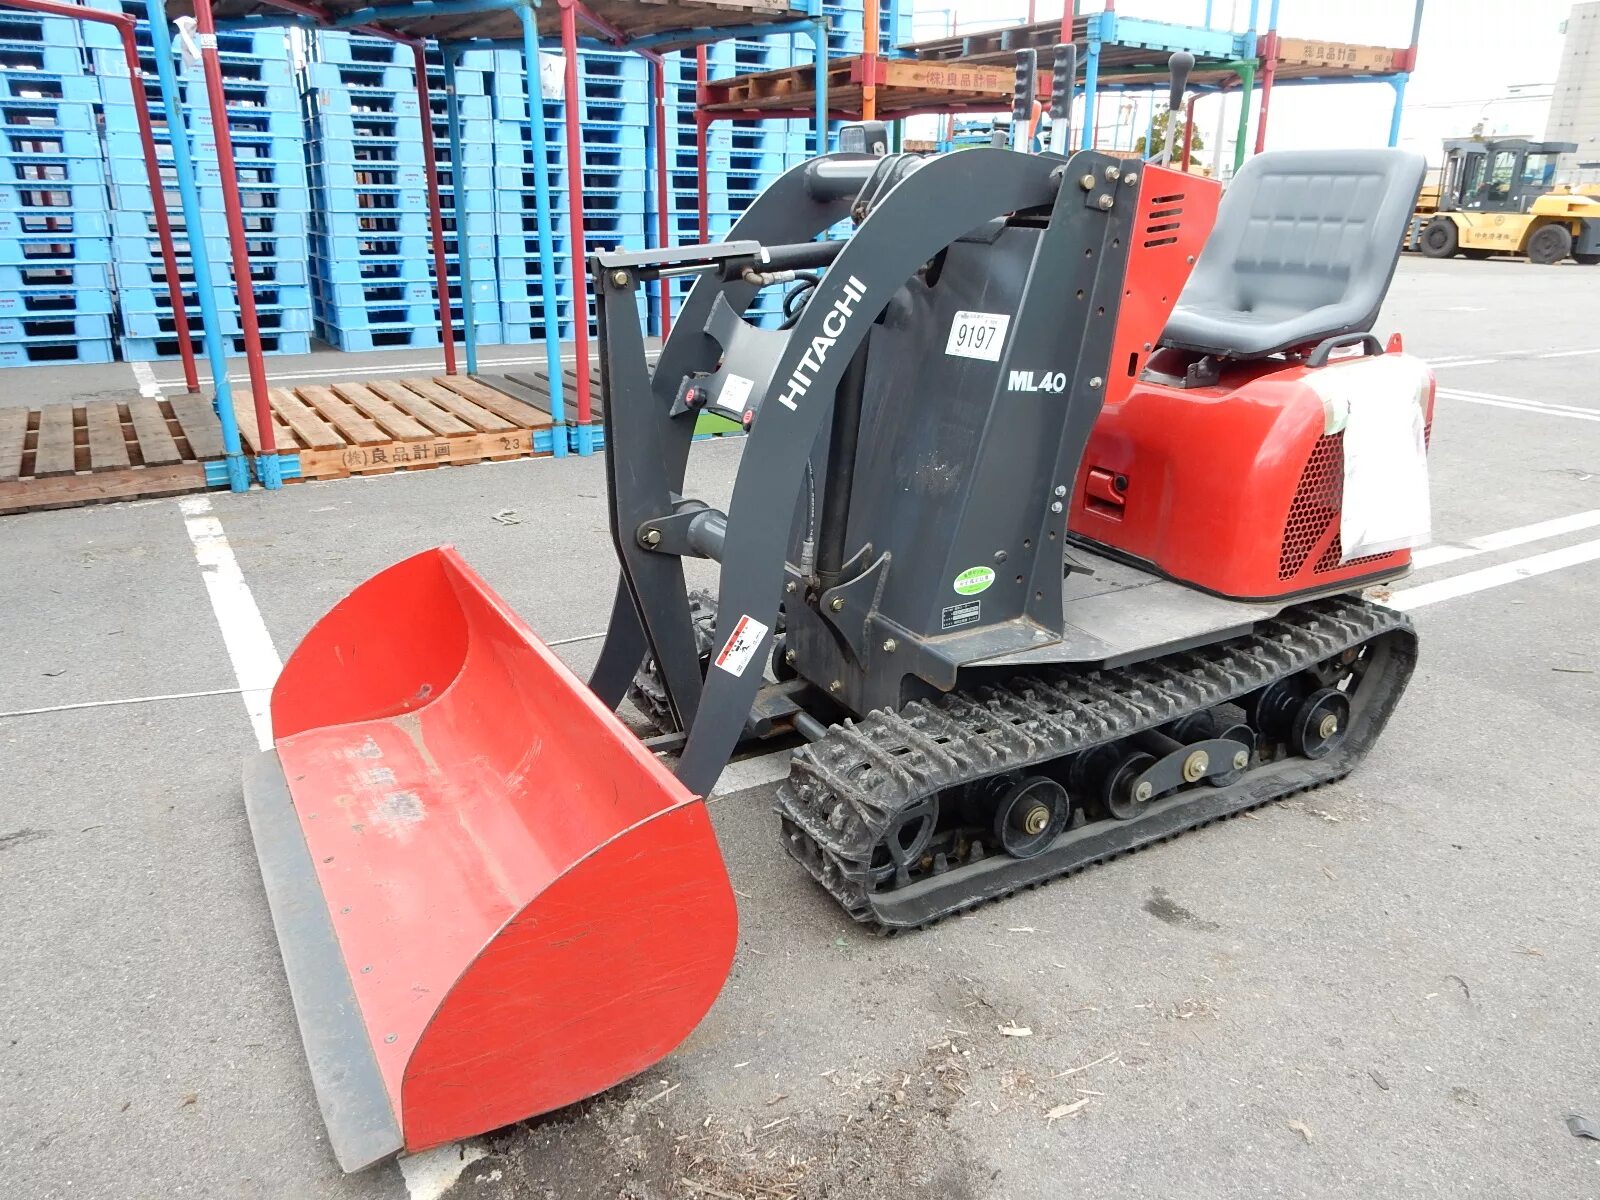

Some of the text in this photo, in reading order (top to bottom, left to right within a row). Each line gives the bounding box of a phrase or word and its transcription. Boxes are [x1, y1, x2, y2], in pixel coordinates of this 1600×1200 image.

[778, 275, 868, 412] HITACHI
[956, 323, 996, 350] 9197
[1007, 370, 1067, 393] ML40
[342, 442, 451, 467] (株)良品計画
[502, 438, 520, 451] 23
